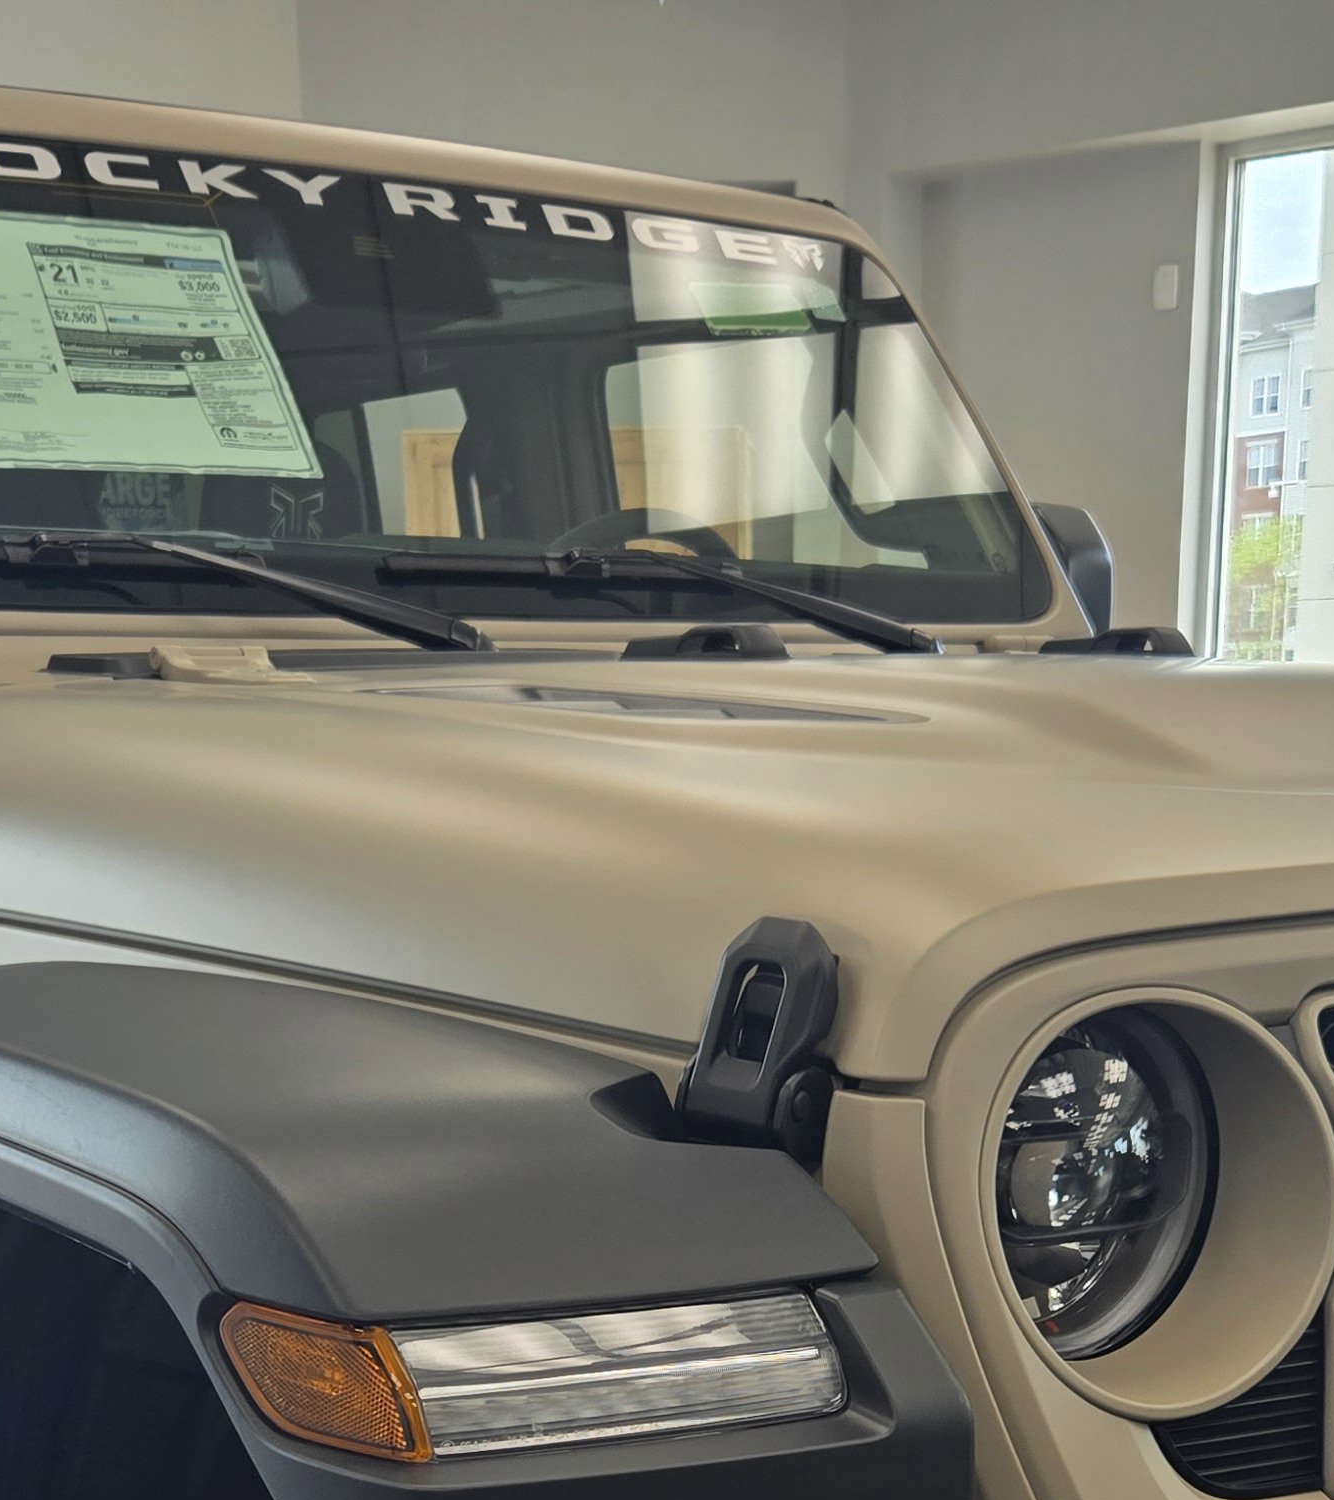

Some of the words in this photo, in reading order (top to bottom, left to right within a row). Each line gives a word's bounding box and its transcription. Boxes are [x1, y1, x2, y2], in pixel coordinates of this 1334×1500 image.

[381, 181, 778, 266] RIDGE
[49, 262, 80, 285] 21
[178, 279, 221, 293] $3,000
[53, 309, 97, 325] $2,500
